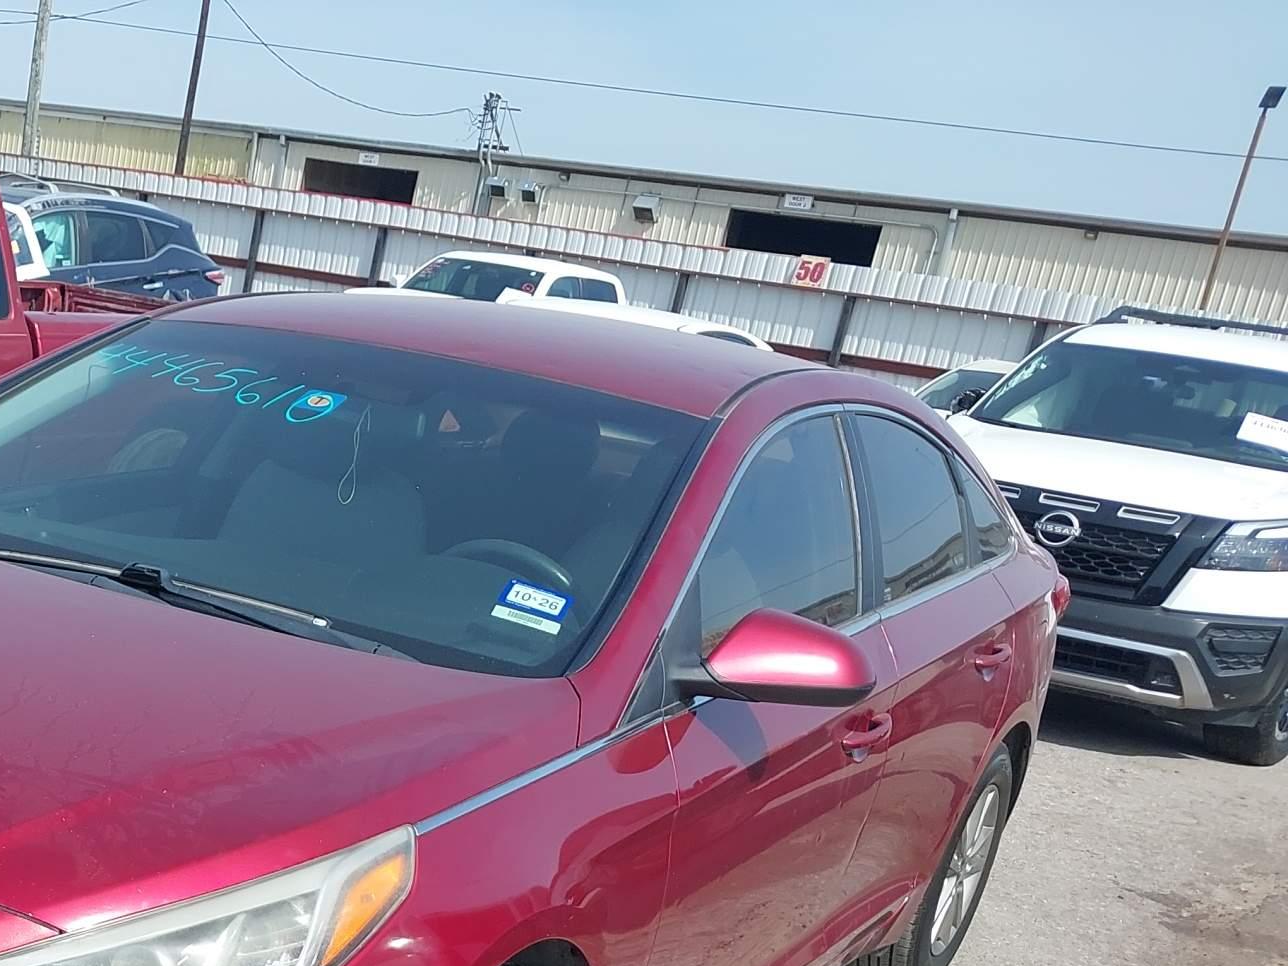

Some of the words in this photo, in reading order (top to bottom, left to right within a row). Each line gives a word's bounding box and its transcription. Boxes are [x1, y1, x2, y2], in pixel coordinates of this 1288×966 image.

[795, 260, 826, 283] 50
[98, 344, 334, 422] 44465610
[1033, 520, 1081, 537] NISSAN
